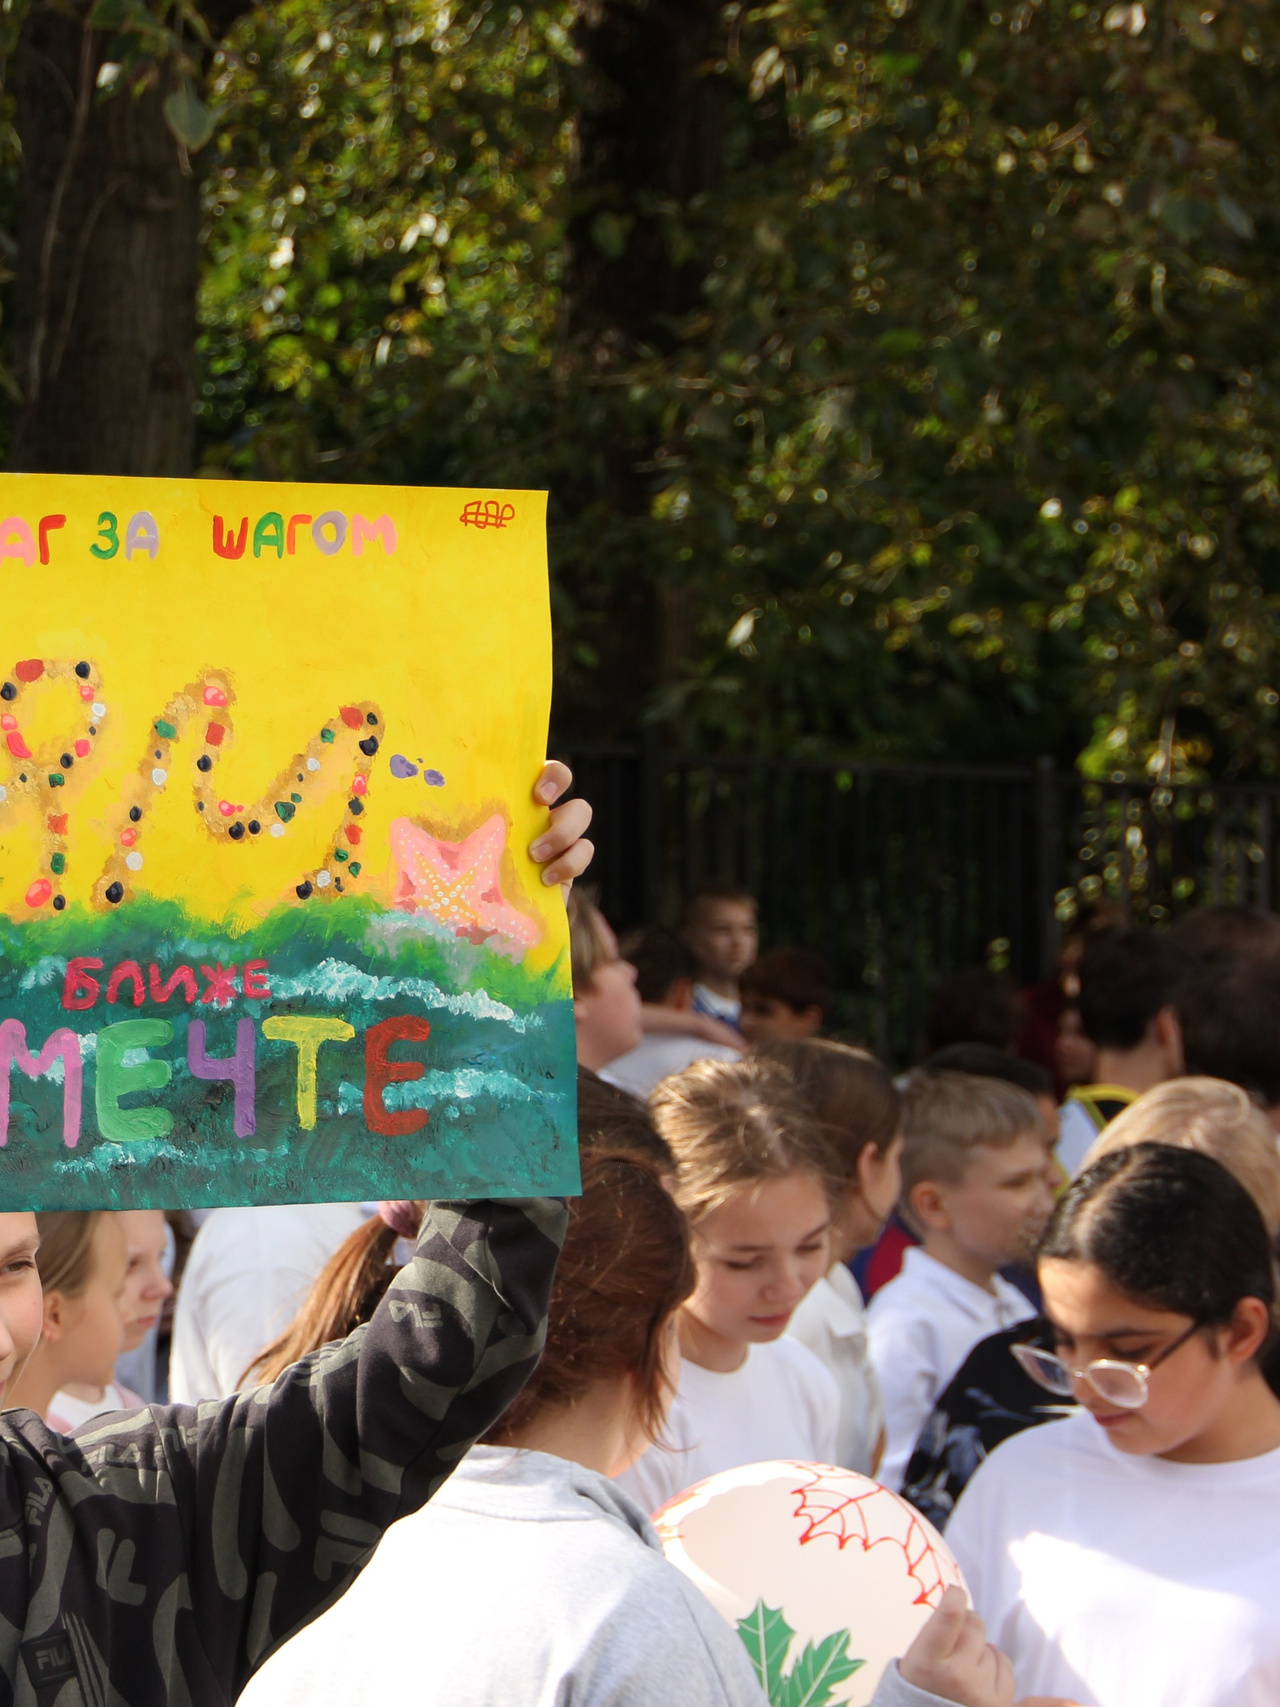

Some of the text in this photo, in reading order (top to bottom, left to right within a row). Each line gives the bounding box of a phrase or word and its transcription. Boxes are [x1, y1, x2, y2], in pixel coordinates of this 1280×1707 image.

[90, 511, 159, 561] ЗА
[213, 510, 398, 560] ШАГОМ
[60, 957, 272, 1011] БЛИЖЕ
[24, 1477, 54, 1527] FILA
